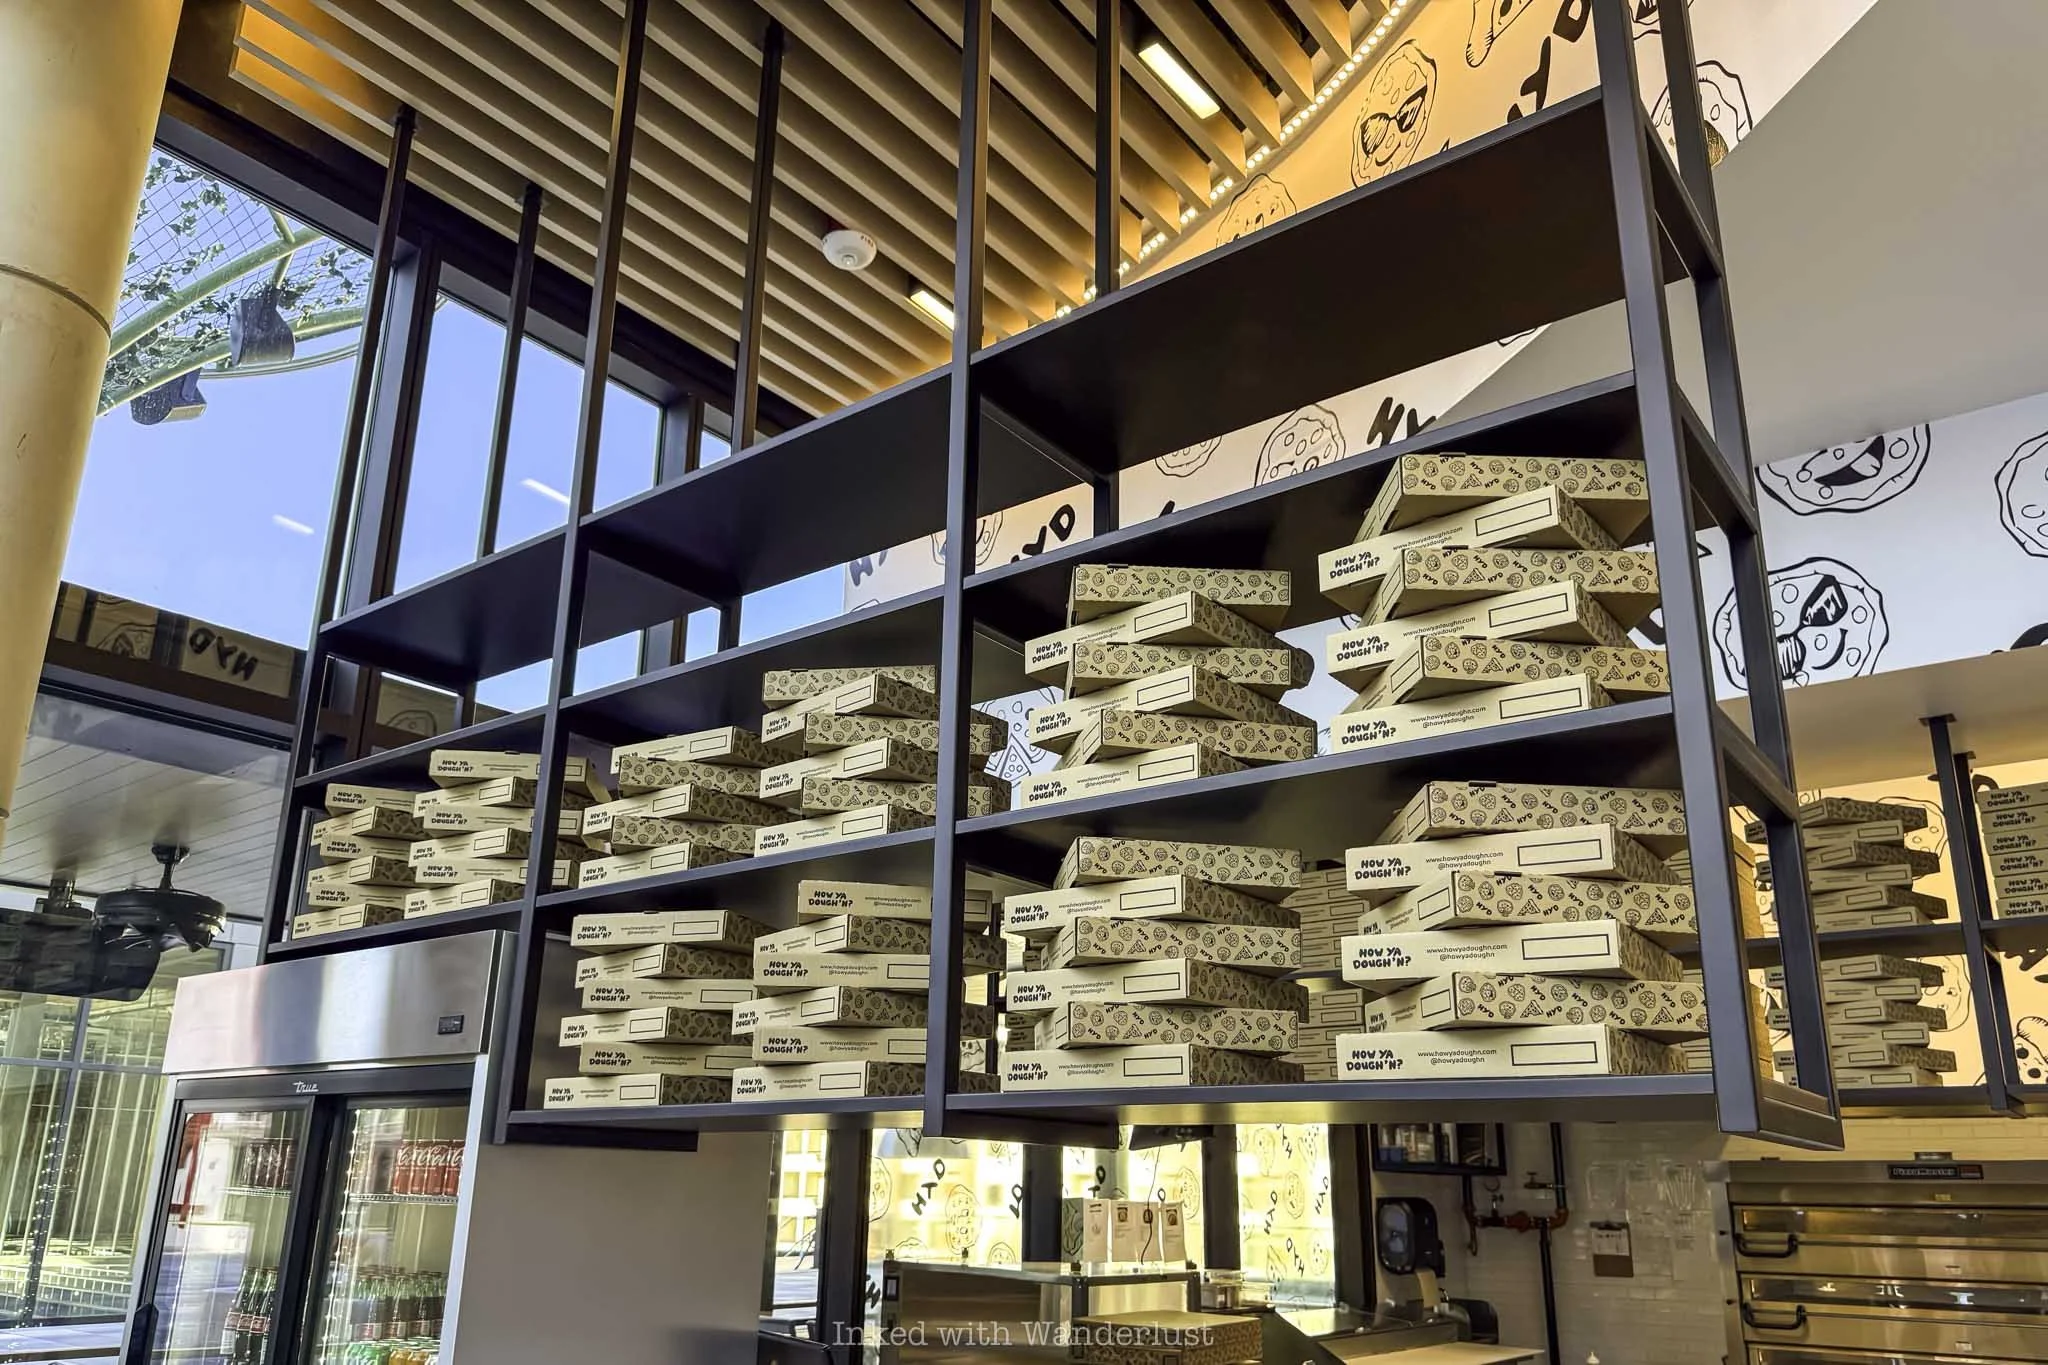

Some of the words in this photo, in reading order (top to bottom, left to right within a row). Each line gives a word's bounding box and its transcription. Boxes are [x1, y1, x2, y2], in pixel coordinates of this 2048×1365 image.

[1470, 462, 1484, 474] HYD
[1508, 467, 1524, 478] HYD
[1592, 464, 1606, 478] HYD
[1421, 479, 1436, 490] HYD
[1485, 478, 1500, 488] HYD
[1606, 481, 1621, 491] HYD
[1393, 526, 1462, 550] www.howyadoughn.com
[1335, 556, 1354, 568] HOW
[1357, 552, 1372, 562] YA
[1474, 555, 1488, 568] HYD
[1512, 560, 1528, 572] HYD
[1599, 558, 1613, 571] HYD
[1330, 558, 1380, 580] DOUGH'N?
[1423, 574, 1438, 584] HYD
[1488, 572, 1503, 583] HYD
[1403, 616, 1476, 637] www.howyadoughn.com
[1036, 644, 1051, 654] HOW
[1052, 641, 1062, 650] YA
[1342, 640, 1364, 652] HOW
[1366, 636, 1381, 648] YA
[1336, 643, 1389, 662] DOUGH'N?
[1492, 645, 1505, 658] HYD
[1530, 652, 1544, 664] HYD
[1442, 660, 1458, 673] HYD
[1506, 663, 1520, 674] HYD
[1039, 714, 1055, 724] HOW
[1055, 712, 1066, 720] YA
[1410, 706, 1486, 724] www.howyadoughn.com
[1348, 724, 1370, 734] HOW
[1373, 720, 1387, 732] YA
[1422, 716, 1474, 728] @howyadoughn
[1342, 727, 1396, 746] DOUGH'N?
[1033, 784, 1050, 793] HOW
[1050, 781, 1062, 790] YA
[1600, 790, 1616, 800] HYD
[1502, 795, 1516, 808] HYD
[1542, 801, 1558, 814] HYD
[1632, 799, 1648, 813] HYD
[1449, 813, 1465, 825] HYD
[1517, 812, 1532, 824] HYD
[1361, 858, 1386, 868] HOW
[1388, 858, 1402, 868] YA
[1426, 852, 1504, 864] www.howyadoughn.com
[1438, 860, 1491, 869] @howyadoughn
[1355, 866, 1411, 880] DOUGH'N?
[1528, 885, 1543, 900] HYD
[1568, 892, 1584, 906] HYD
[1655, 894, 1670, 910] HYD
[1015, 906, 1031, 914] HOW
[1032, 904, 1042, 913] YA
[1476, 902, 1492, 916] HYD
[1543, 904, 1559, 916] HYD
[1359, 948, 1383, 958] HOW
[1386, 947, 1402, 958] YA
[1426, 944, 1507, 955] www.howyadoughn.com
[1353, 956, 1411, 969] DOUGH'N?
[1440, 952, 1494, 962] @howyadoughn
[769, 960, 787, 968] HOW
[1018, 986, 1034, 994] HOW
[1035, 984, 1046, 993] YA
[1531, 986, 1546, 1000] HYD
[1572, 993, 1588, 1007] HYD
[1478, 1004, 1494, 1018] HYD
[1546, 1006, 1562, 1018] HYD
[1609, 1011, 1626, 1024] HYD
[768, 1038, 787, 1046] HOW
[790, 1038, 801, 1046] YA
[1352, 1050, 1378, 1059] HOW
[1379, 1049, 1394, 1058] YA
[1418, 1048, 1496, 1058] www.howyadoughn.com
[1012, 1063, 1029, 1072] HOW
[1030, 1063, 1042, 1071] YA
[1346, 1058, 1403, 1071] DOUGH'N?
